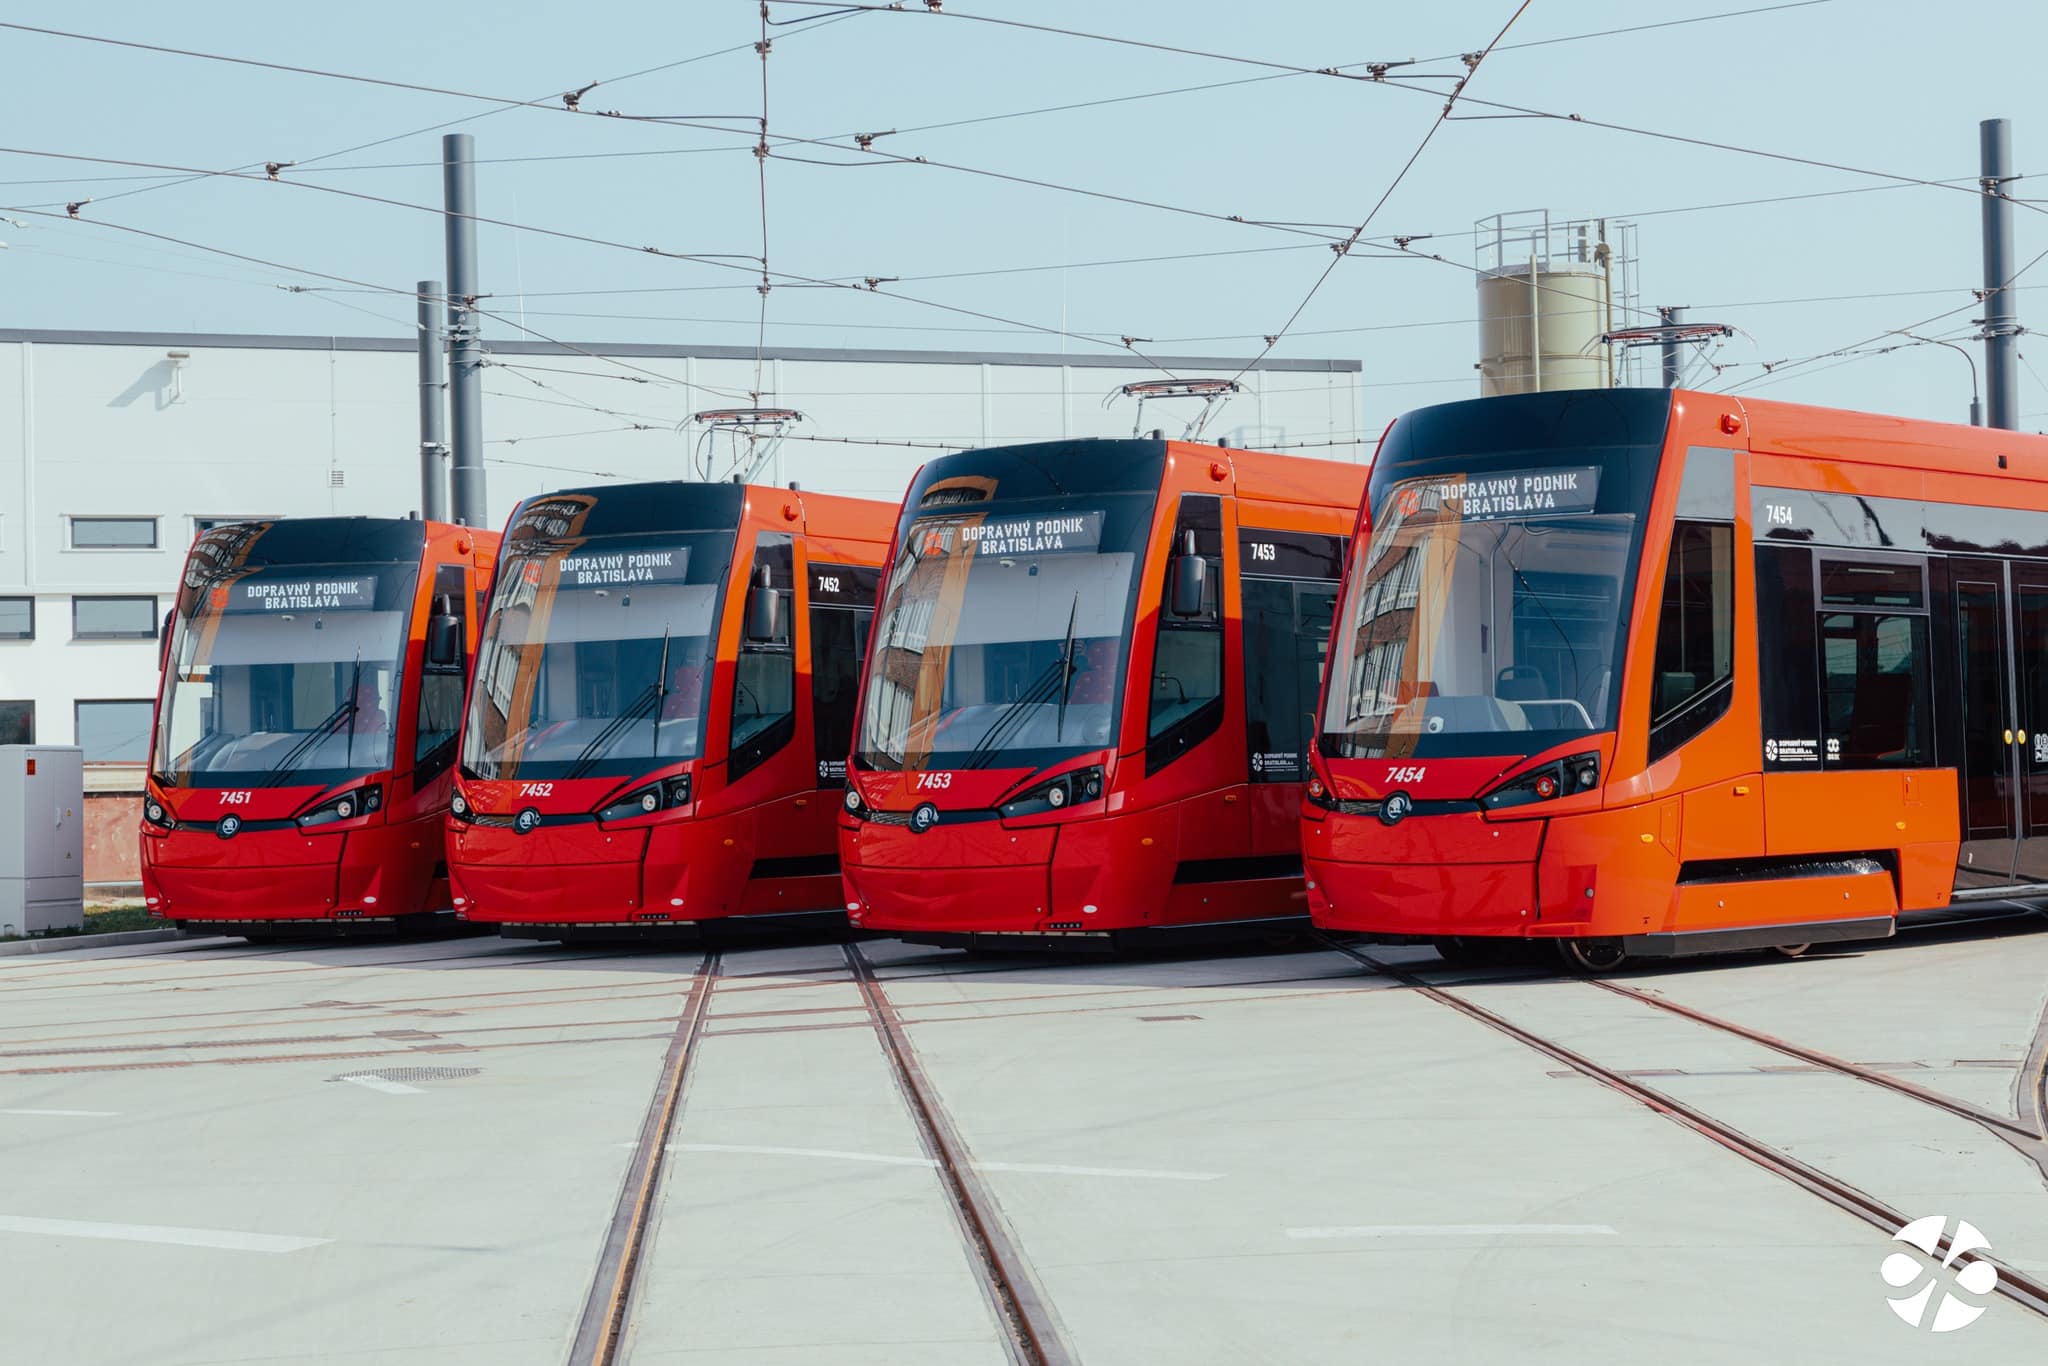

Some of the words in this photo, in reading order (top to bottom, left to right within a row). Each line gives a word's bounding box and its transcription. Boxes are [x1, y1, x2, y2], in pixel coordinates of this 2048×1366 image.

[1440, 476, 1518, 500] DOPRAVNÝ
[1523, 473, 1578, 494] PODNIK
[1462, 493, 1556, 515] BRATISLAVA
[1766, 505, 1793, 525] 7454
[962, 520, 1031, 541] DOPRAVNÝ
[1035, 518, 1084, 536] PODNIK
[981, 535, 1063, 555] BRATISLAVA
[1251, 543, 1276, 561] 7453
[559, 553, 624, 572] DOPRAVNÝ
[628, 552, 673, 568] PODNIK
[577, 568, 654, 584] BRATISLAVA
[817, 576, 840, 593] 7452
[247, 581, 311, 598] DOPRAVNÝ
[315, 581, 359, 596] PODNIK
[264, 595, 341, 609] BRATISLAVA
[916, 772, 953, 790] 7453
[1384, 766, 1427, 784] 7454
[219, 791, 252, 805] 7451
[519, 782, 554, 798] 7452
